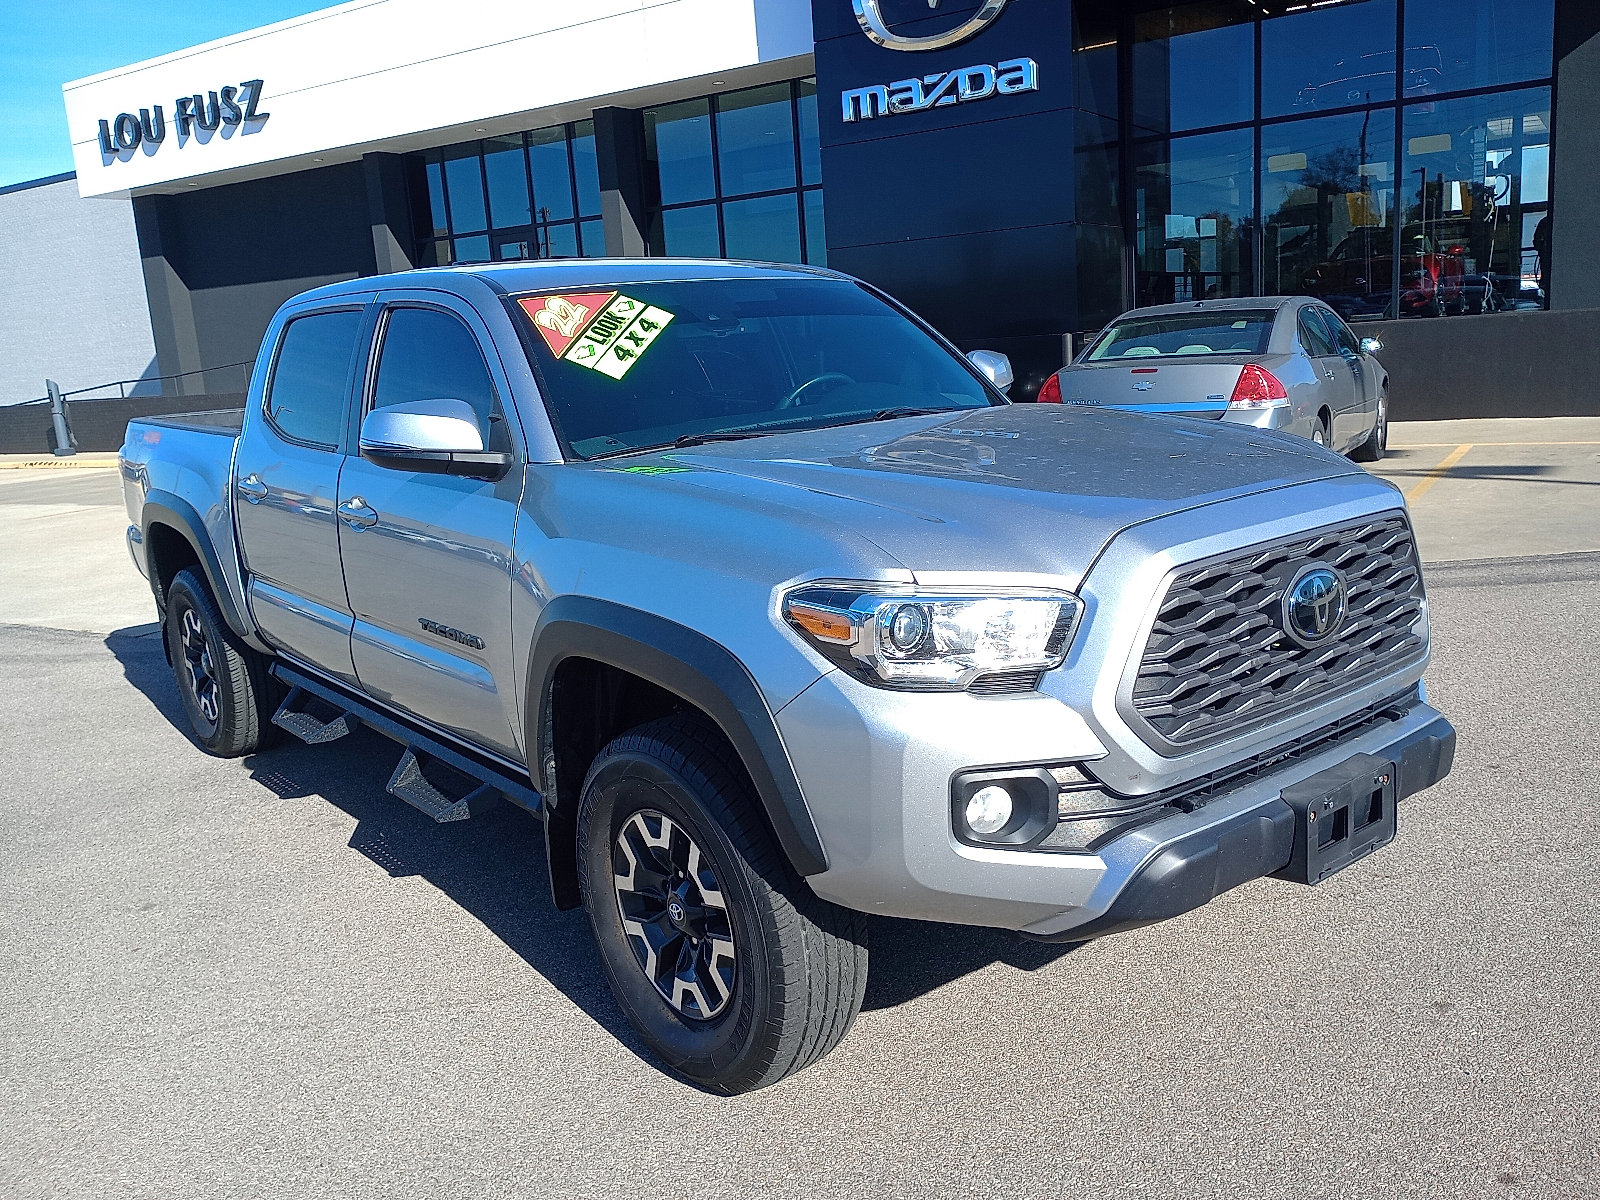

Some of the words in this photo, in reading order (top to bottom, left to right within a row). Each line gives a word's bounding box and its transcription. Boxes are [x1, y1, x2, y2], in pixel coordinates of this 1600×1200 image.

[98, 105, 166, 154] LOU
[175, 79, 270, 136] FUSZ
[534, 296, 591, 338] 22
[584, 311, 628, 346] LOOK
[417, 617, 486, 650] TACOMA
